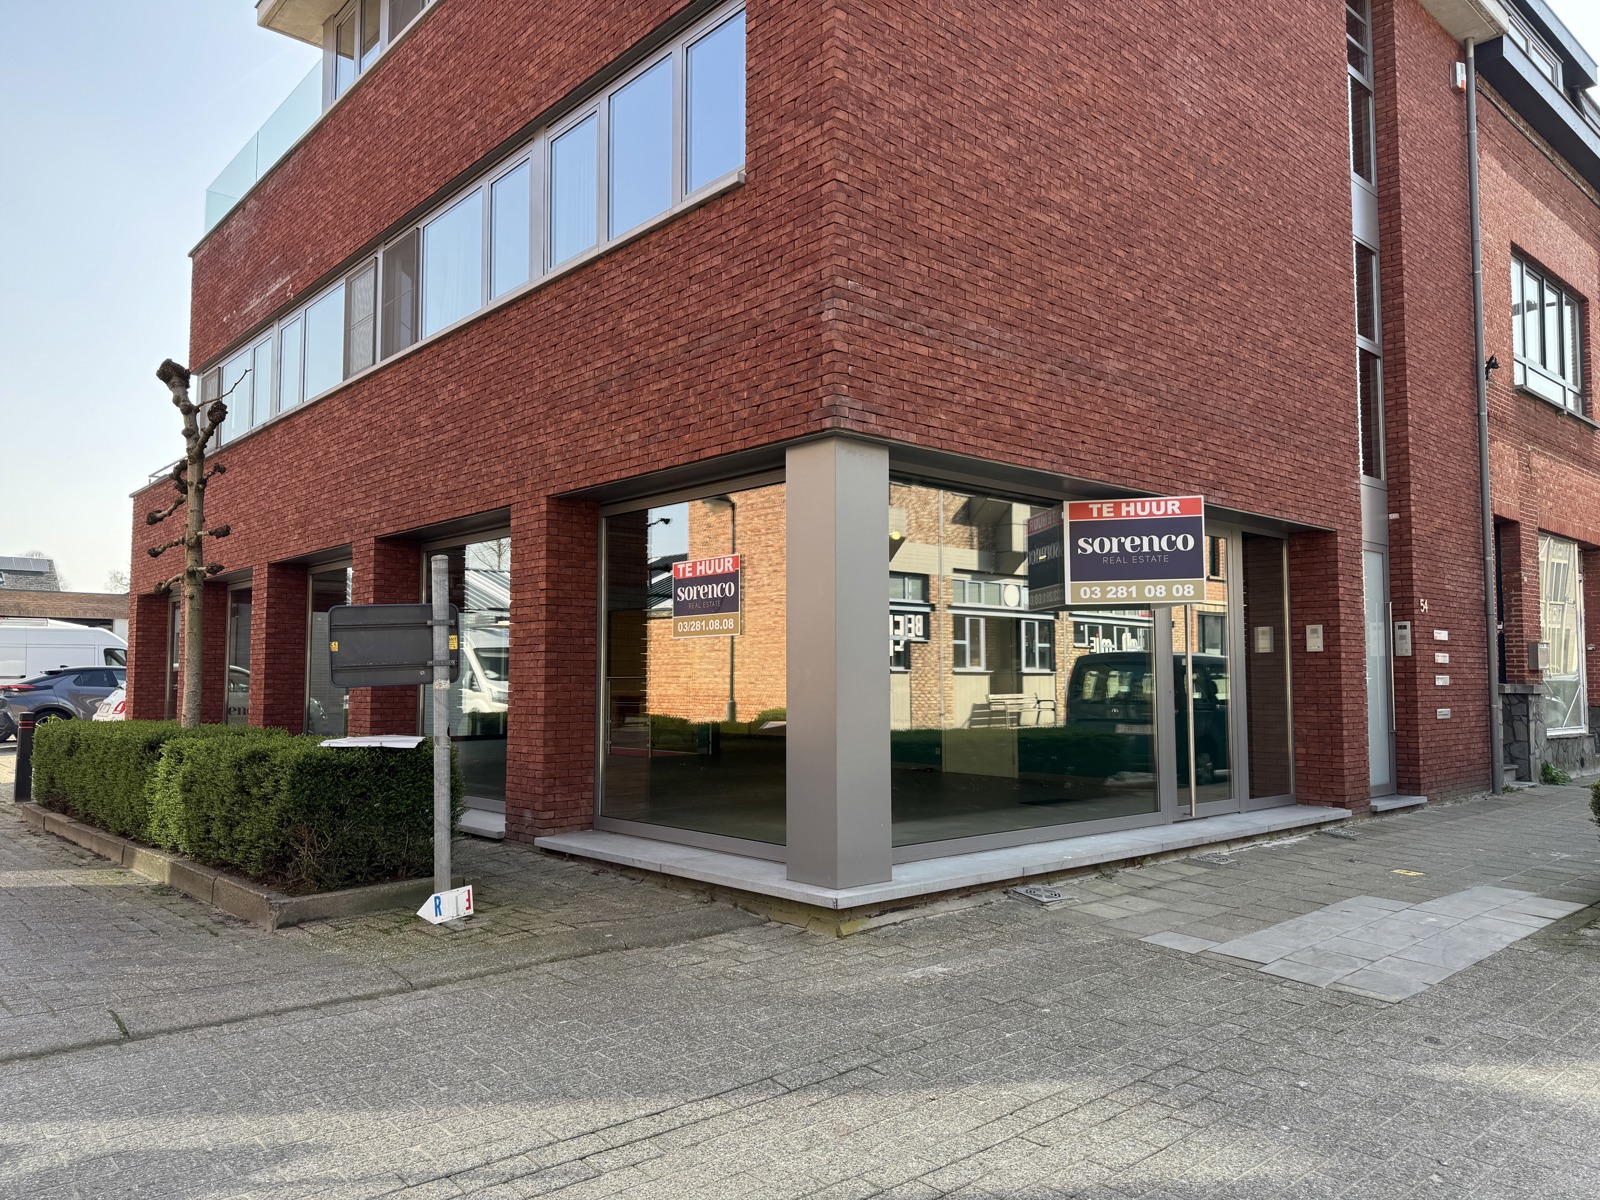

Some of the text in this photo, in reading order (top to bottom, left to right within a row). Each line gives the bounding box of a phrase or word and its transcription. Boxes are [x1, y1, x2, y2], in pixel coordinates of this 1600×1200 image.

[1088, 500, 1181, 517] TE HUUR
[1077, 533, 1195, 555] sorenco
[1102, 554, 1169, 564] REAL ESTATE
[677, 557, 734, 578] TE HUUR
[677, 581, 735, 602] sorenco
[1080, 584, 1195, 599] 03 281 08 08
[688, 600, 721, 609] REAL ESTATE
[1419, 599, 1429, 613] 54
[677, 618, 734, 632] 03/281.08.08
